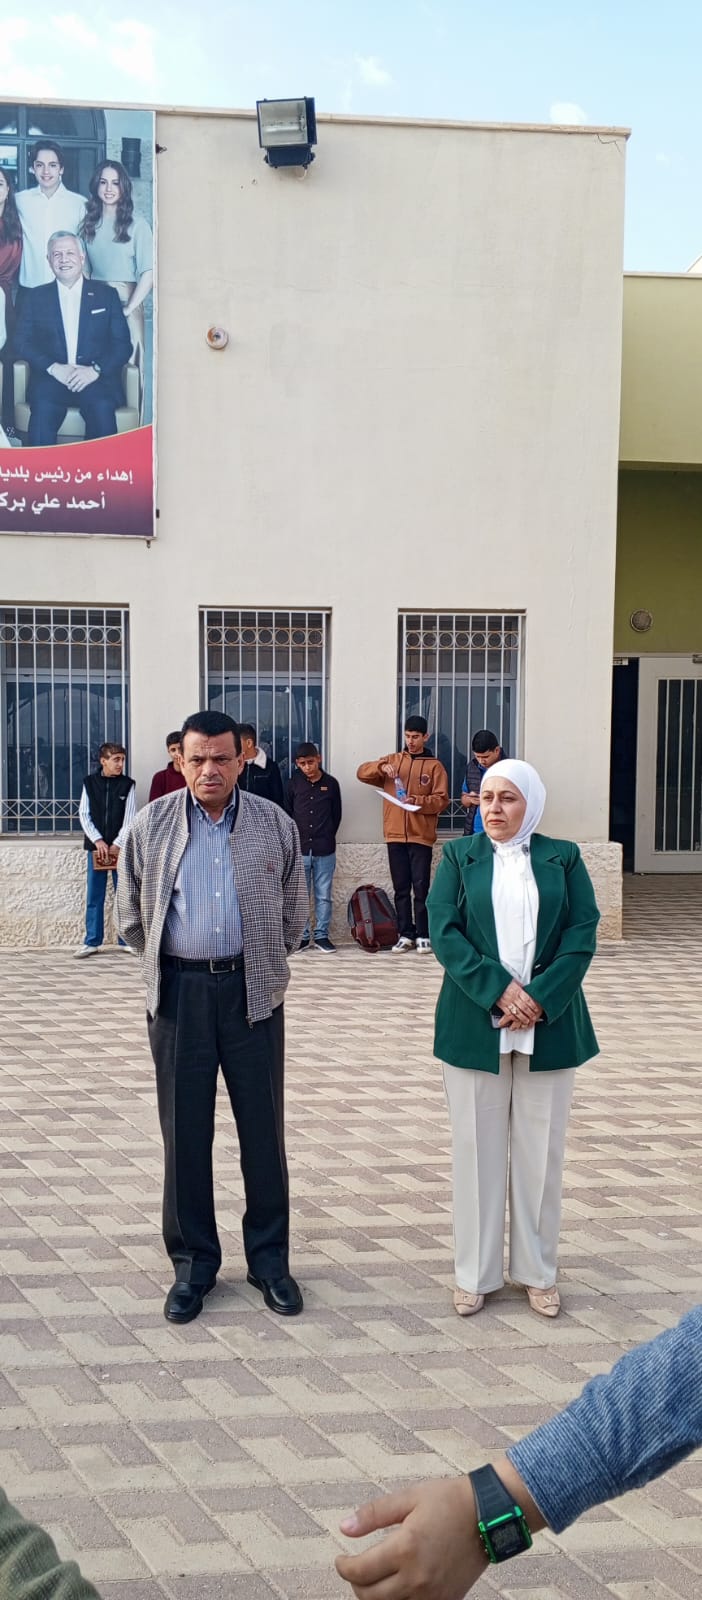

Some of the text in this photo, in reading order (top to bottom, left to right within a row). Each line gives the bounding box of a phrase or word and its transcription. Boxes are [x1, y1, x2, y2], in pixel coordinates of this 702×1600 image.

[0, 464, 134, 485] إهداء من رئيس بلدي
[31, 492, 60, 515] علي
[66, 490, 106, 510] أحمد
